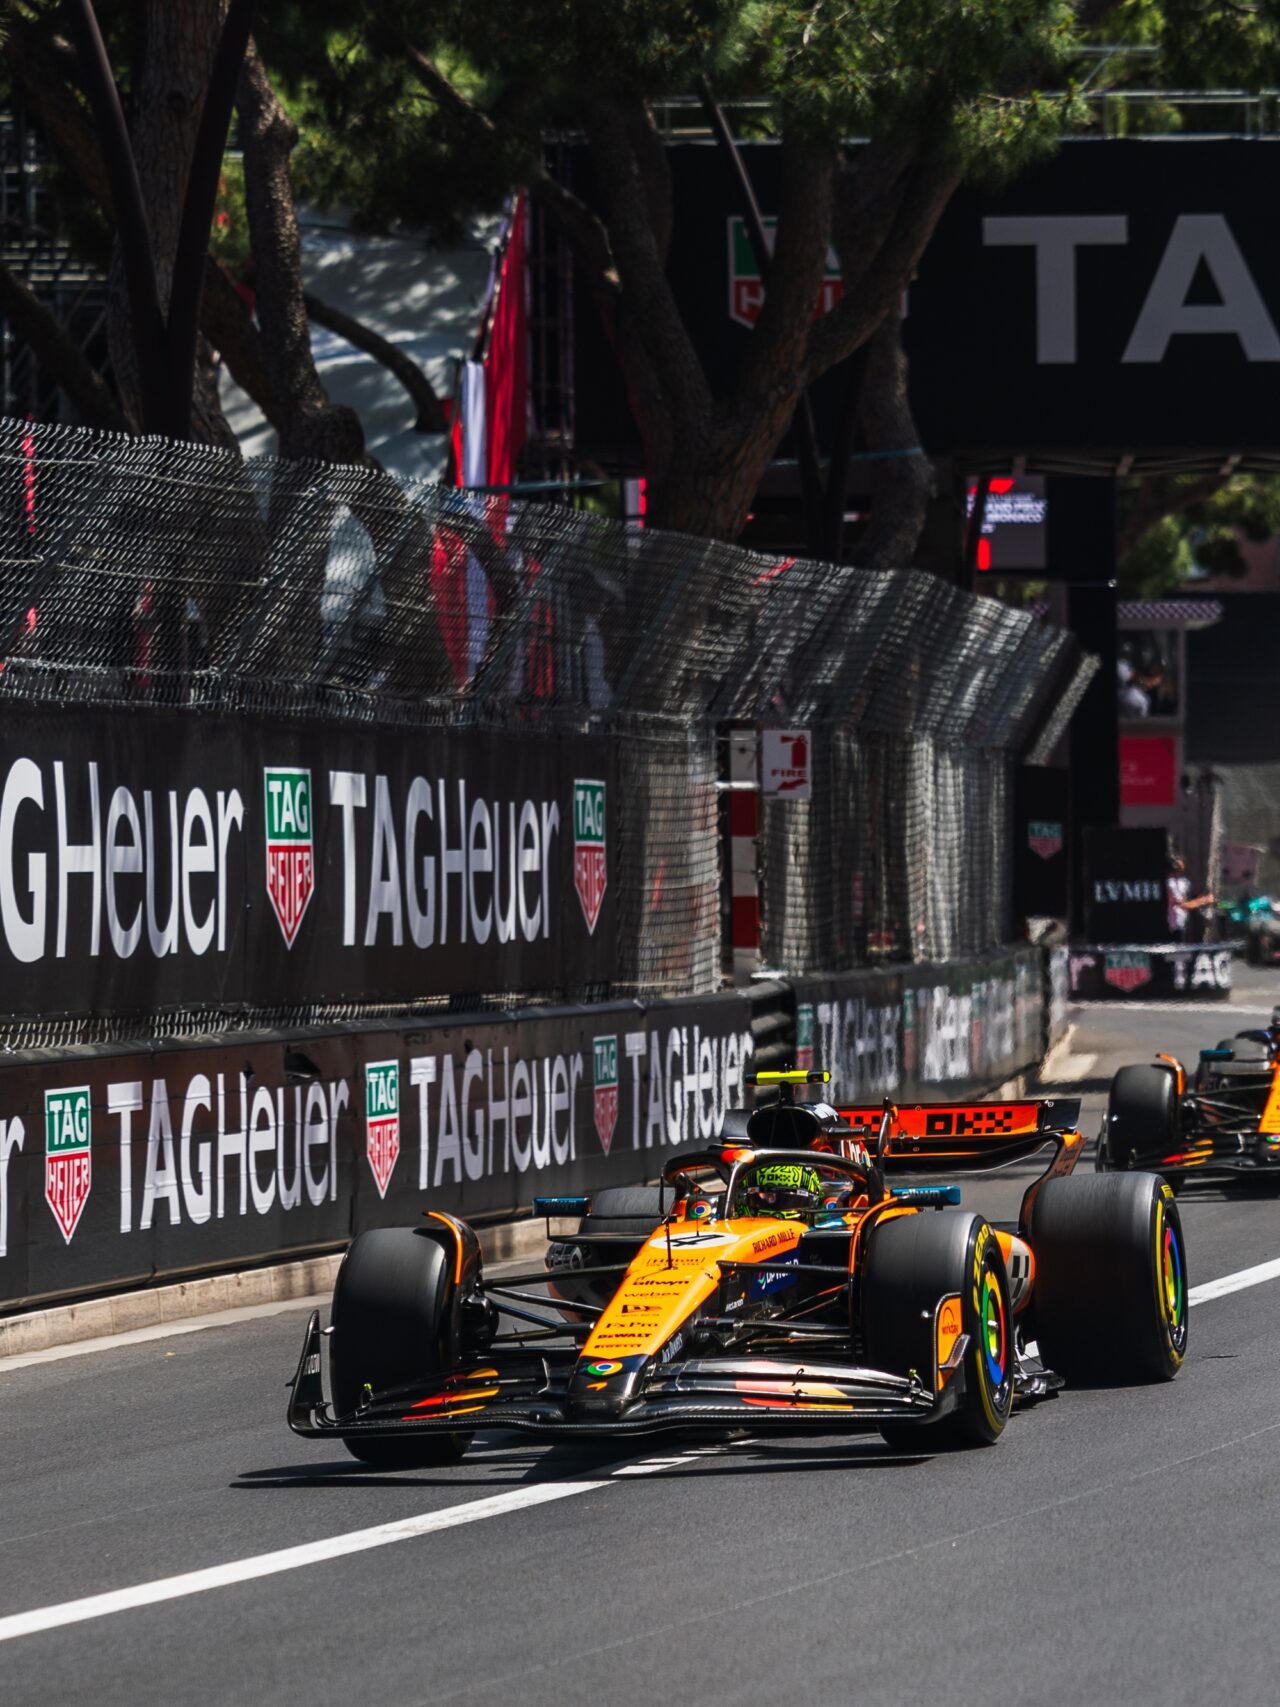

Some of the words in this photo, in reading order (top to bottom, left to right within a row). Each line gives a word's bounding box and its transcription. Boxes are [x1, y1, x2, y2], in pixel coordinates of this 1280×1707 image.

[771, 768, 807, 778] FIRE
[268, 780, 308, 833] TAG
[576, 791, 604, 836] TAG
[268, 852, 312, 931] HEUER
[1093, 879, 1162, 904] LVMH
[595, 1044, 617, 1083] TAG
[368, 1070, 396, 1112] TAG
[49, 1096, 88, 1146] TAG
[925, 1111, 1013, 1136] OKX
[367, 1123, 400, 1191] HEUER
[48, 1158, 89, 1228] HEUER
[751, 1234, 778, 1254] RICHARD
[777, 1228, 796, 1246] MILLE
[633, 1279, 690, 1287] allwyn
